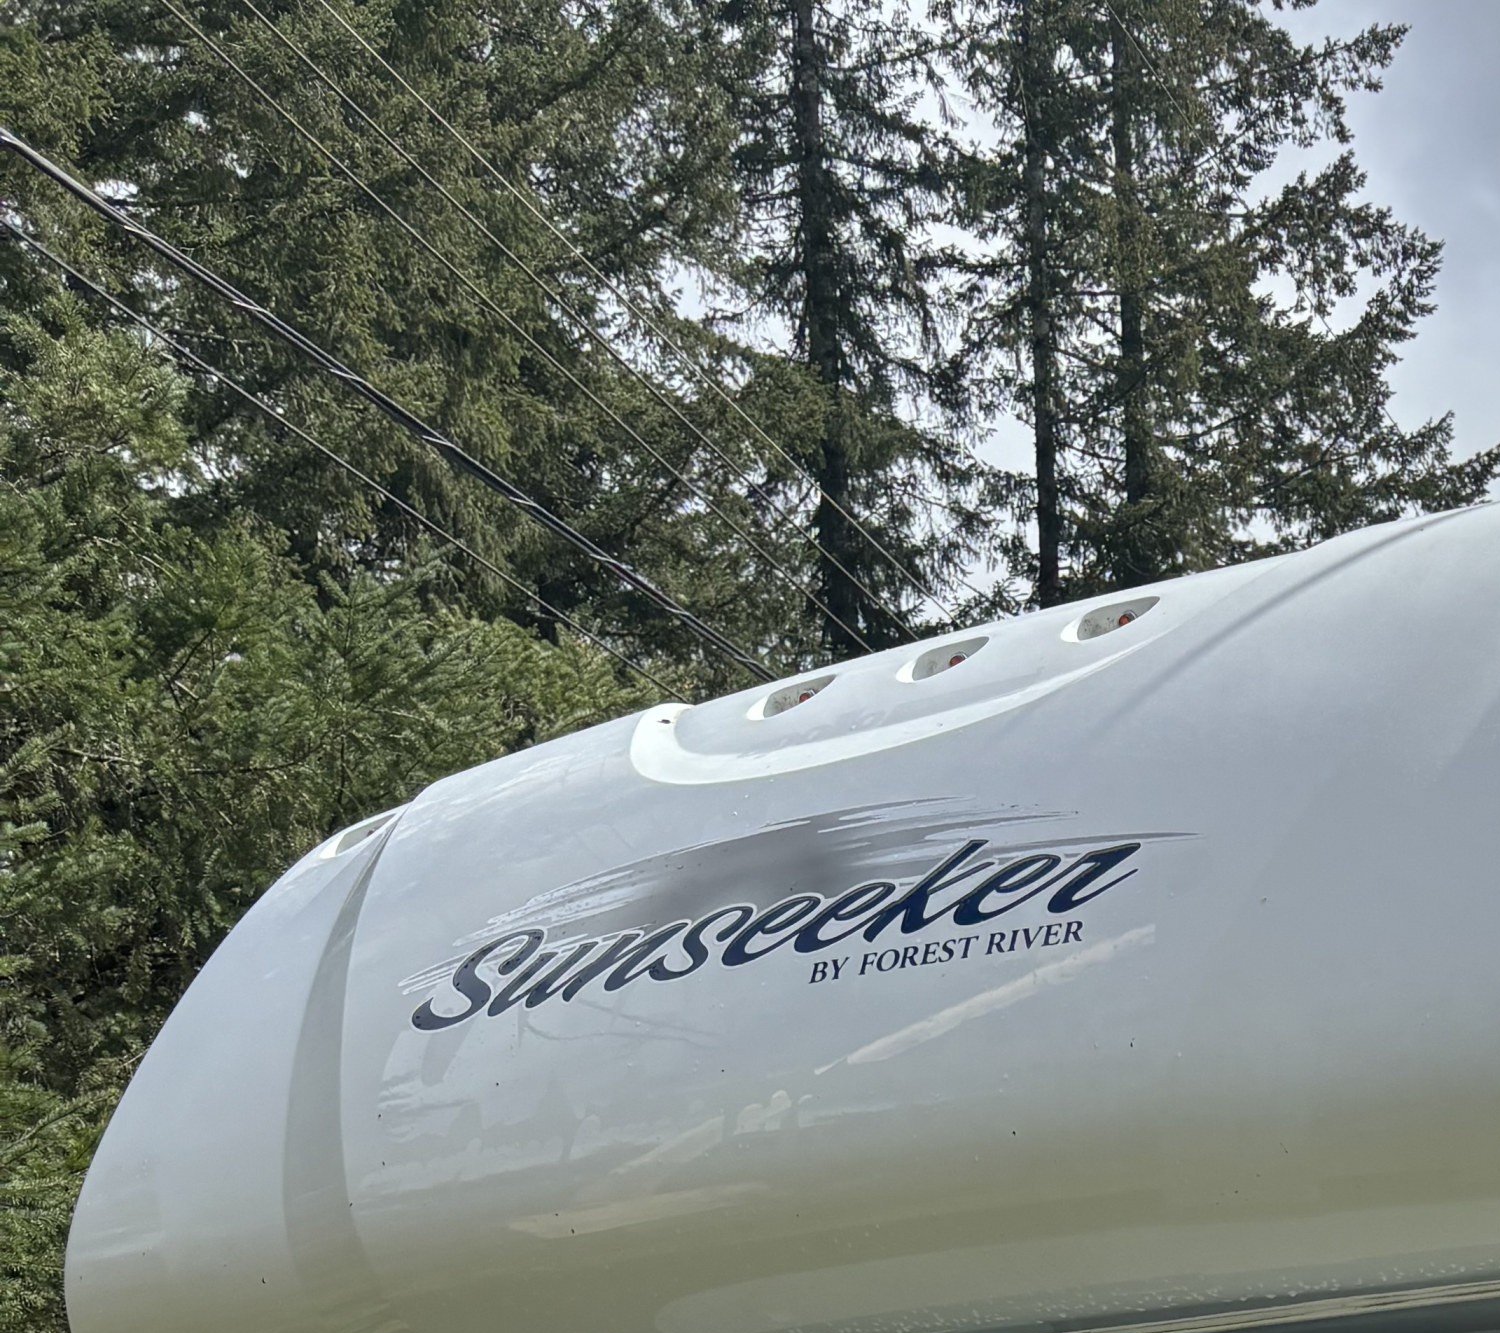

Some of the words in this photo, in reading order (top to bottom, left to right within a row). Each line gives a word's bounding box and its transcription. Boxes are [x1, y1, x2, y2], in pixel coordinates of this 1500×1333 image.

[411, 838, 1142, 1031] Sunseeker
[808, 956, 850, 984] BY
[858, 936, 979, 976] FOREST
[985, 920, 1084, 955] RIVER
